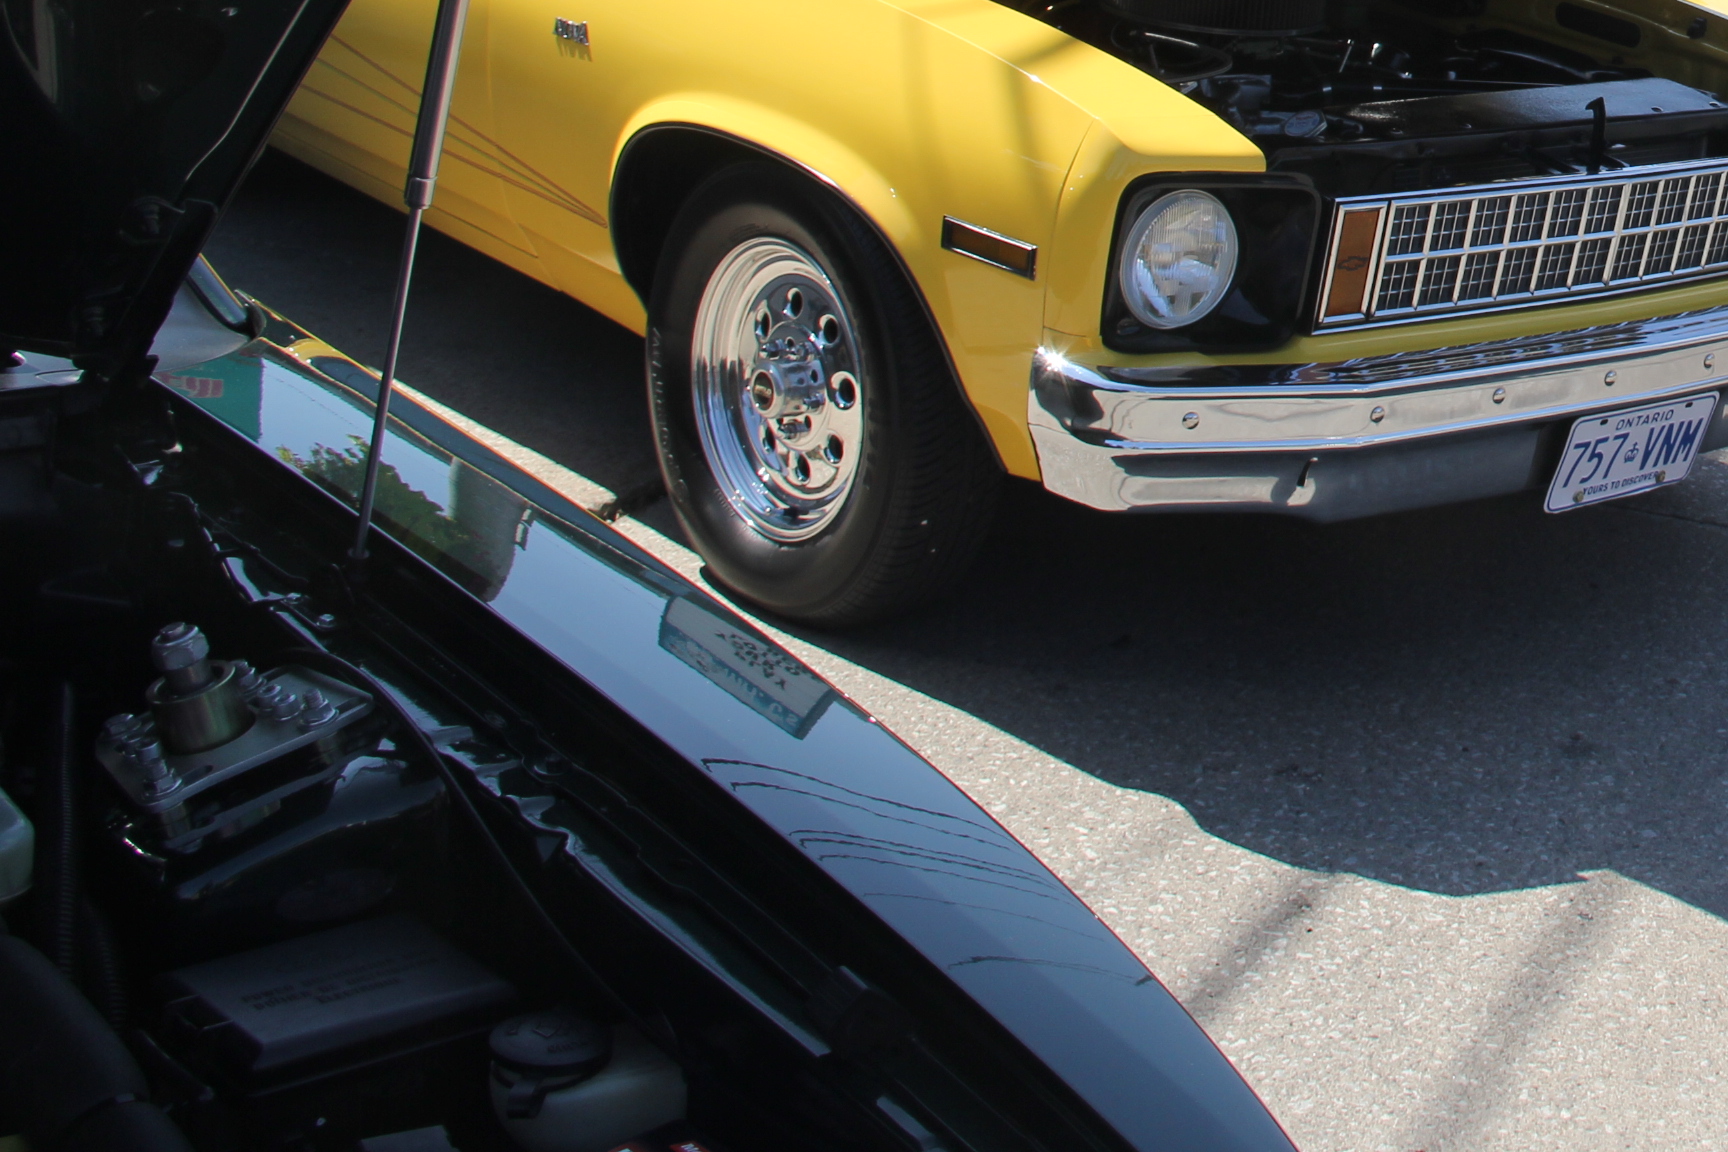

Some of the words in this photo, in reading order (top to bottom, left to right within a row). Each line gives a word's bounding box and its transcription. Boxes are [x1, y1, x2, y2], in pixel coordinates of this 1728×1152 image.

[1615, 409, 1674, 431] ONTARIO
[1562, 432, 1630, 488] 757
[1639, 417, 1704, 471] VNM
[1582, 481, 1608, 496] YOURS
[1610, 480, 1621, 490] TO
